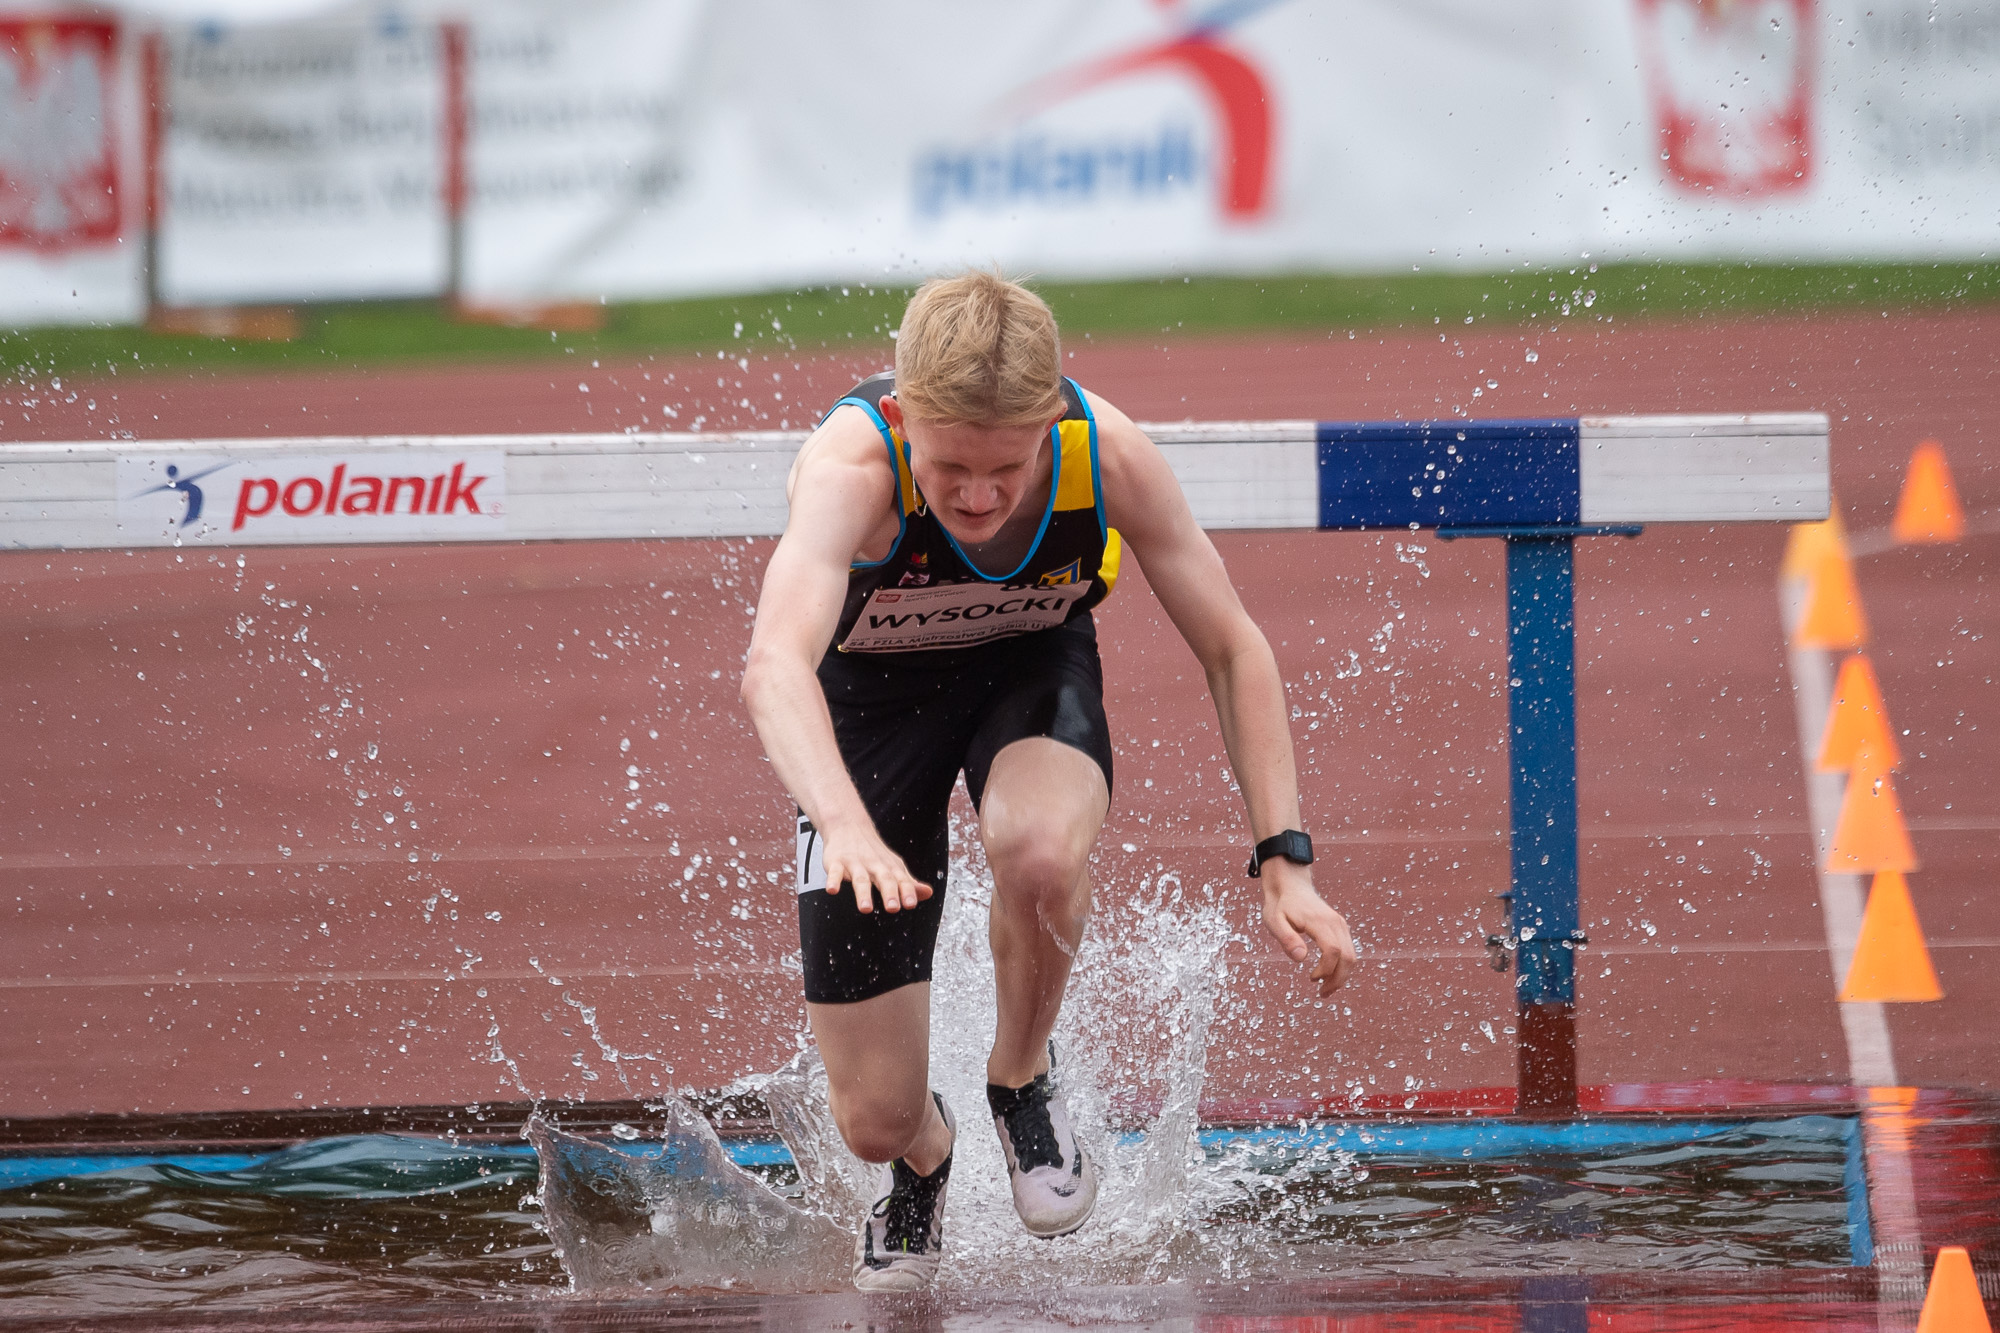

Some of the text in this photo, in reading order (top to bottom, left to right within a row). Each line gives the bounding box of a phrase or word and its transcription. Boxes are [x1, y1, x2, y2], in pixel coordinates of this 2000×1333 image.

[230, 461, 489, 533] polanik
[868, 597, 1067, 631] WYSOCKI
[908, 630, 986, 644] Mistrzostwa
[800, 821, 817, 885] 7
